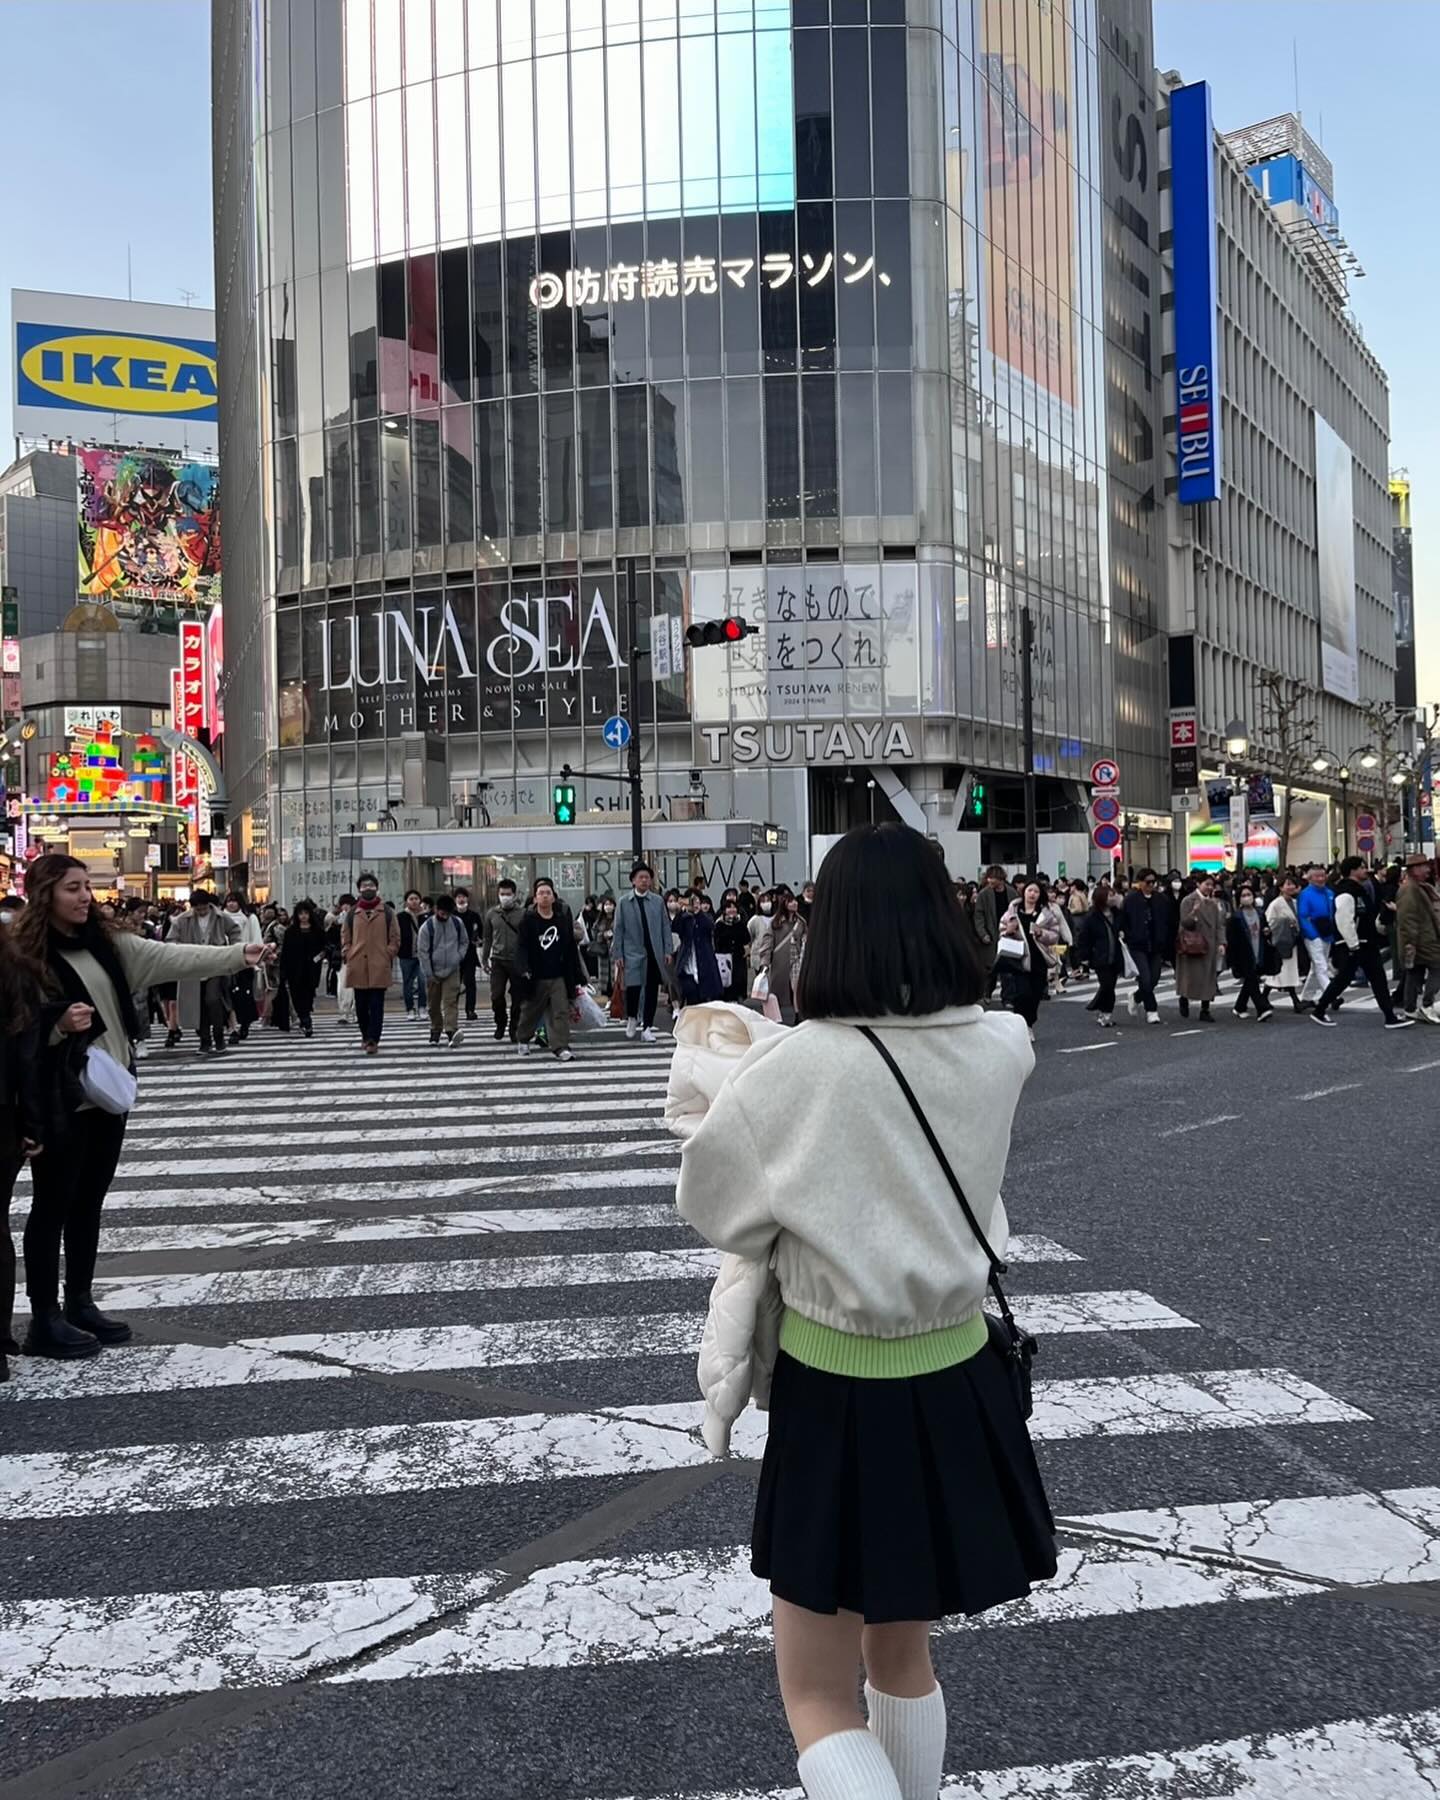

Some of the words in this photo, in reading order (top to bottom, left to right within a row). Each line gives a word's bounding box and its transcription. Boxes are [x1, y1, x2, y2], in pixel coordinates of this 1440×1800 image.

[42, 349, 217, 396] IKEA
[1180, 364, 1210, 479] SEIBU
[319, 600, 478, 692] LUNA
[486, 587, 629, 678] SEA
[184, 634, 202, 717] カラオケ
[423, 688, 462, 698] ALBUMS
[485, 685, 512, 695] NOW
[518, 682, 535, 691] ON
[777, 684, 831, 695] TSUTAYA
[81, 709, 121, 721] れいわ
[323, 703, 466, 732] MOTHER
[483, 704, 495, 717] &
[513, 693, 628, 718] STYLE
[701, 722, 914, 763] TSUTAYA
